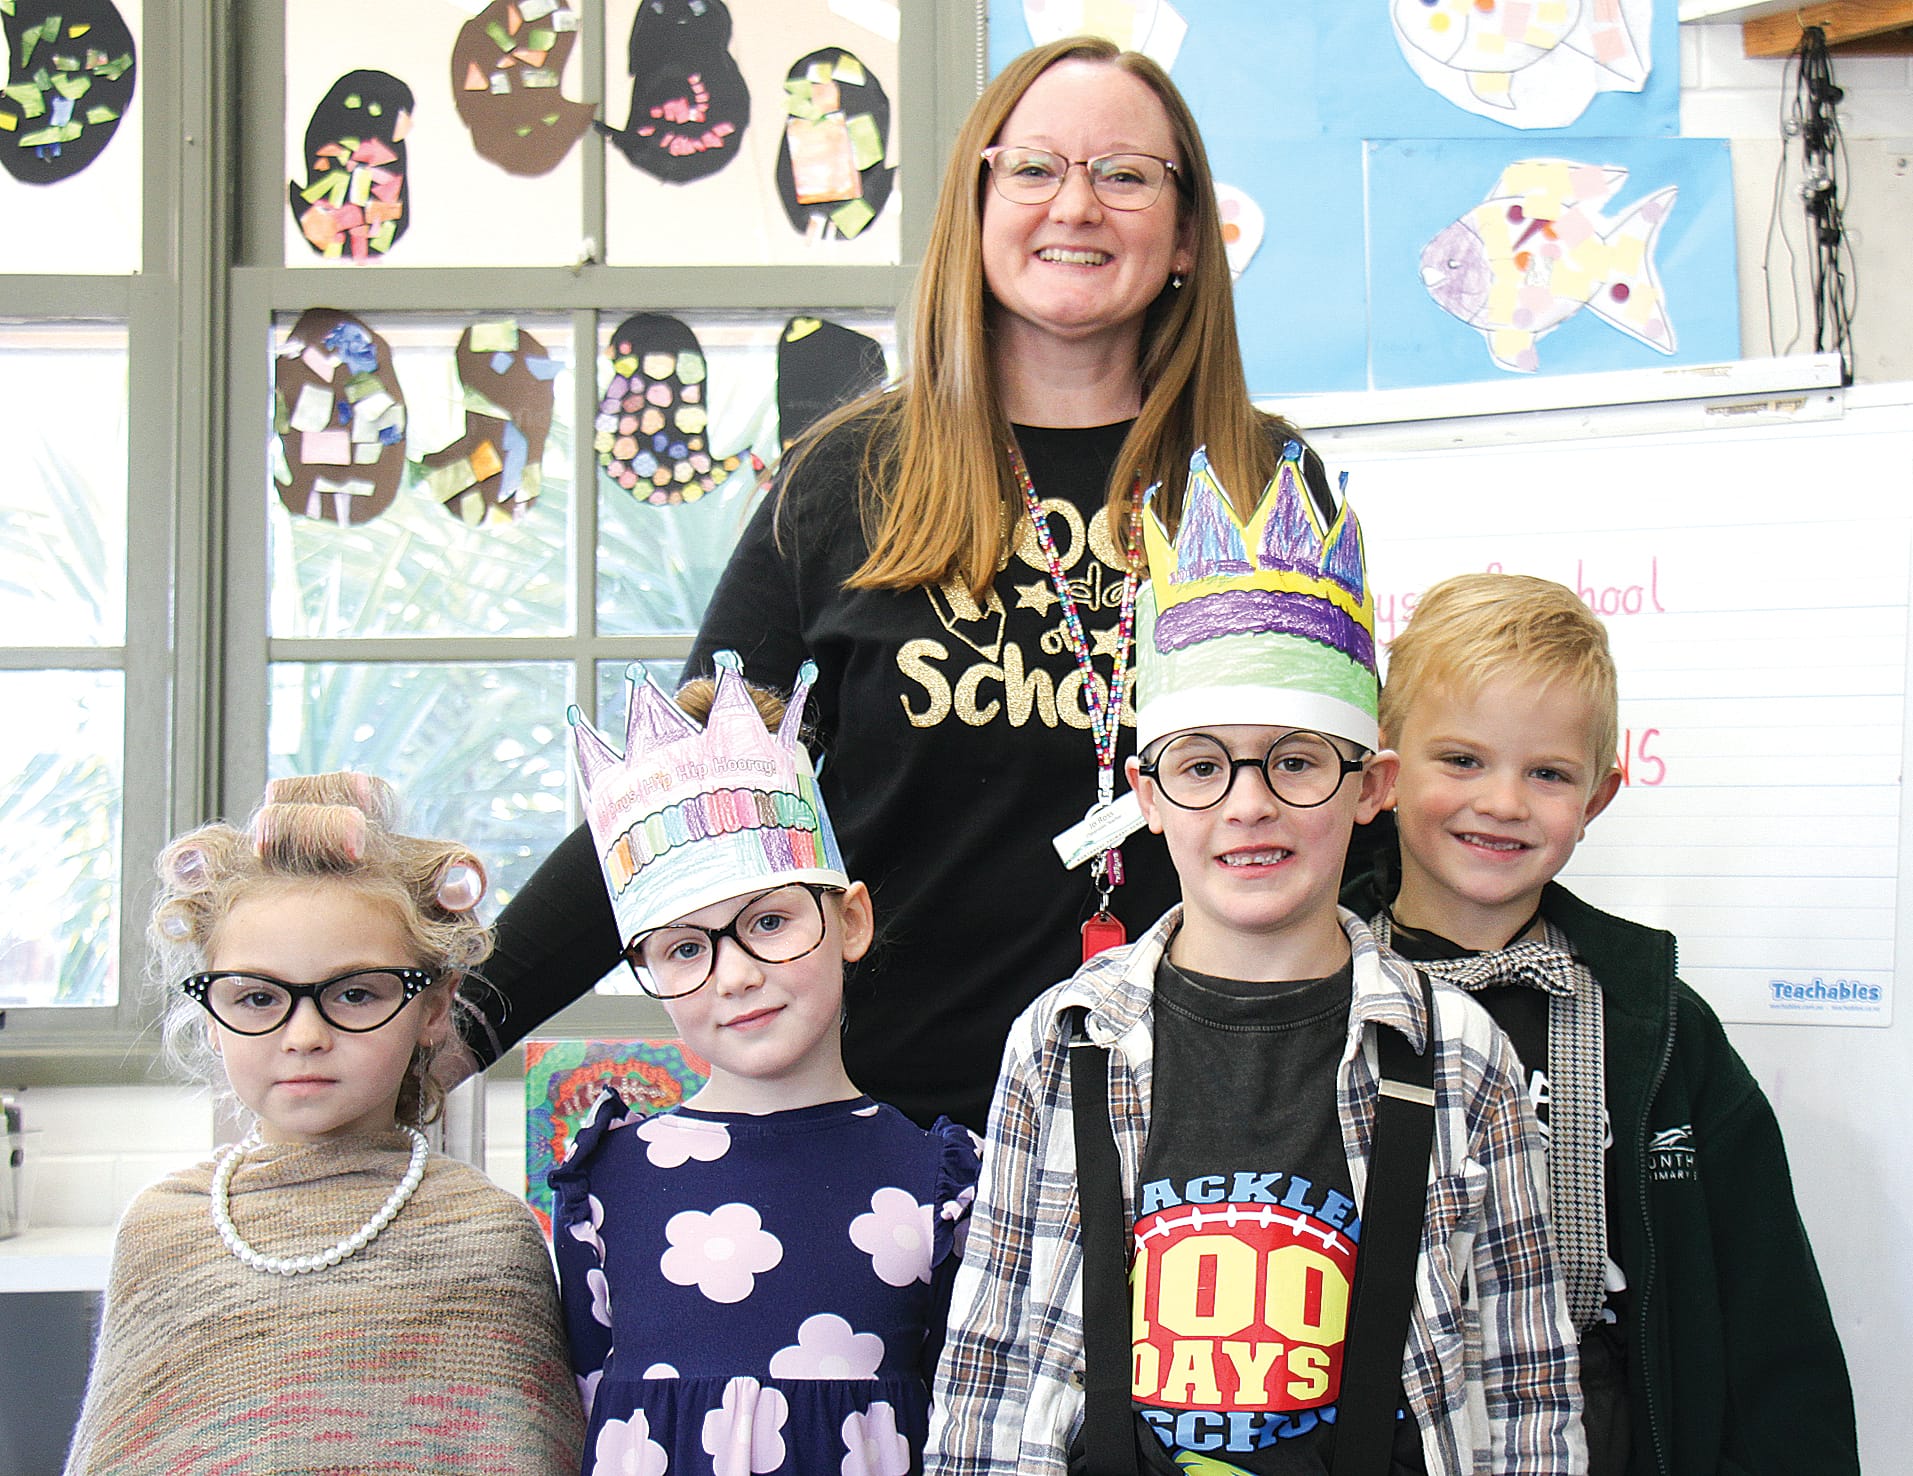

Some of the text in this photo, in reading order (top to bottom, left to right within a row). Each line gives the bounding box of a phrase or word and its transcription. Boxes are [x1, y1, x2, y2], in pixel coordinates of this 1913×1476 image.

[1577, 556, 1665, 616] hool
[897, 638, 1137, 728] Scho
[676, 760, 708, 781] Hip
[712, 756, 777, 777] Hooray!
[1771, 979, 1881, 1002] Teachables
[1140, 1171, 1361, 1245] ACKLE
[1128, 1234, 1350, 1348] 100
[1131, 1339, 1331, 1405] DAYS
